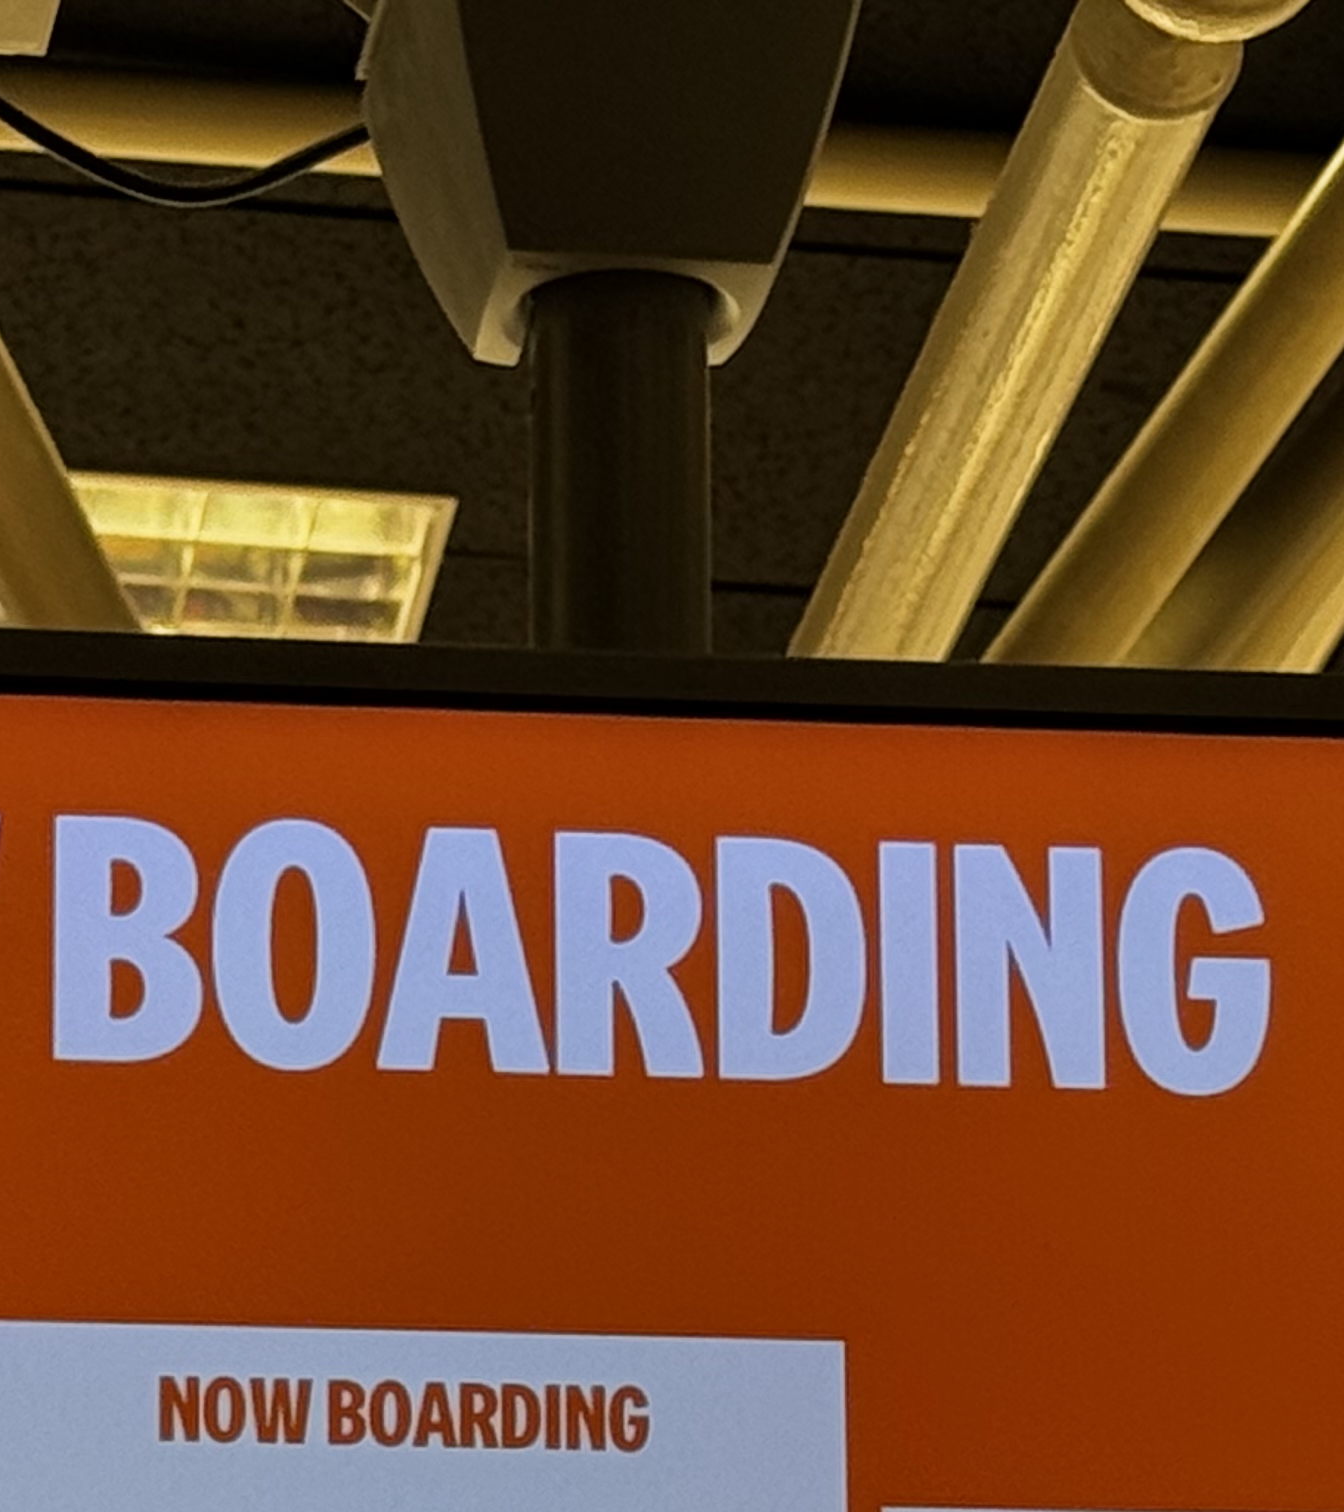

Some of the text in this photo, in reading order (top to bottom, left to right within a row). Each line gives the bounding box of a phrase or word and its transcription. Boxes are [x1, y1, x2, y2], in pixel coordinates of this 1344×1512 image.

[52, 814, 1272, 1097] BOARDING
[158, 1375, 651, 1454] NOW BOARDING
